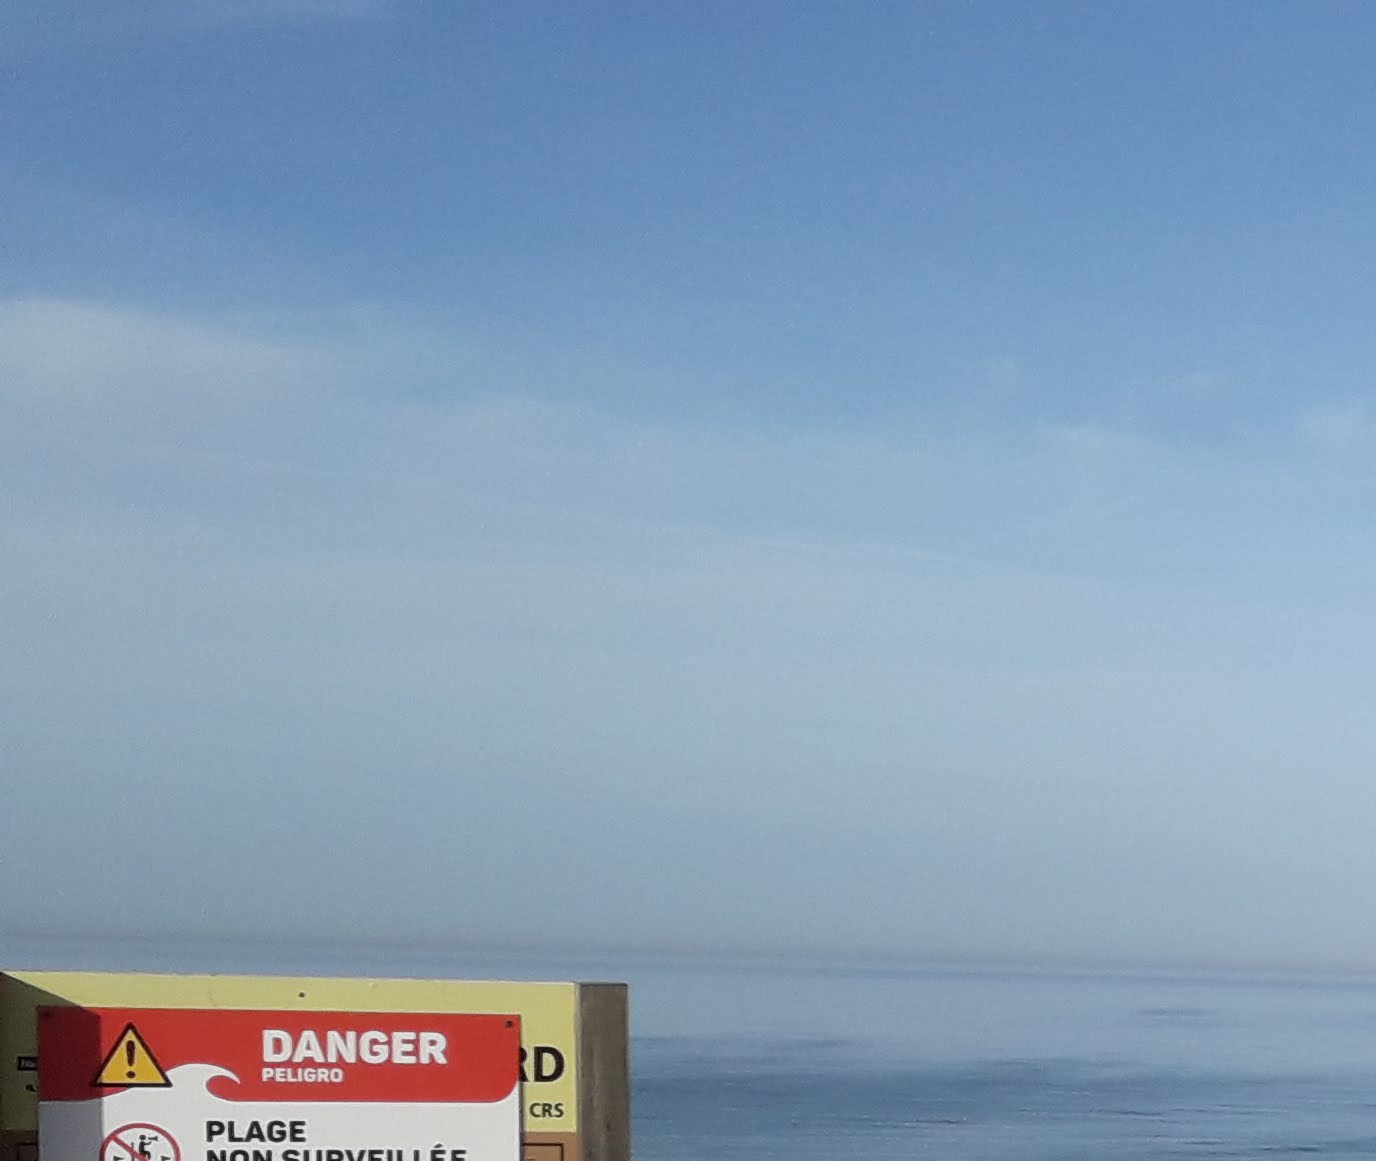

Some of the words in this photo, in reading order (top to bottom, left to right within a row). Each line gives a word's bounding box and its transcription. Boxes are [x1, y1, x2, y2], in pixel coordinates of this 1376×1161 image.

[262, 1029, 447, 1065] DANGER
[262, 1068, 344, 1083] PELIGRO
[529, 1103, 565, 1119] CRS
[206, 1120, 307, 1143] PLAGE
